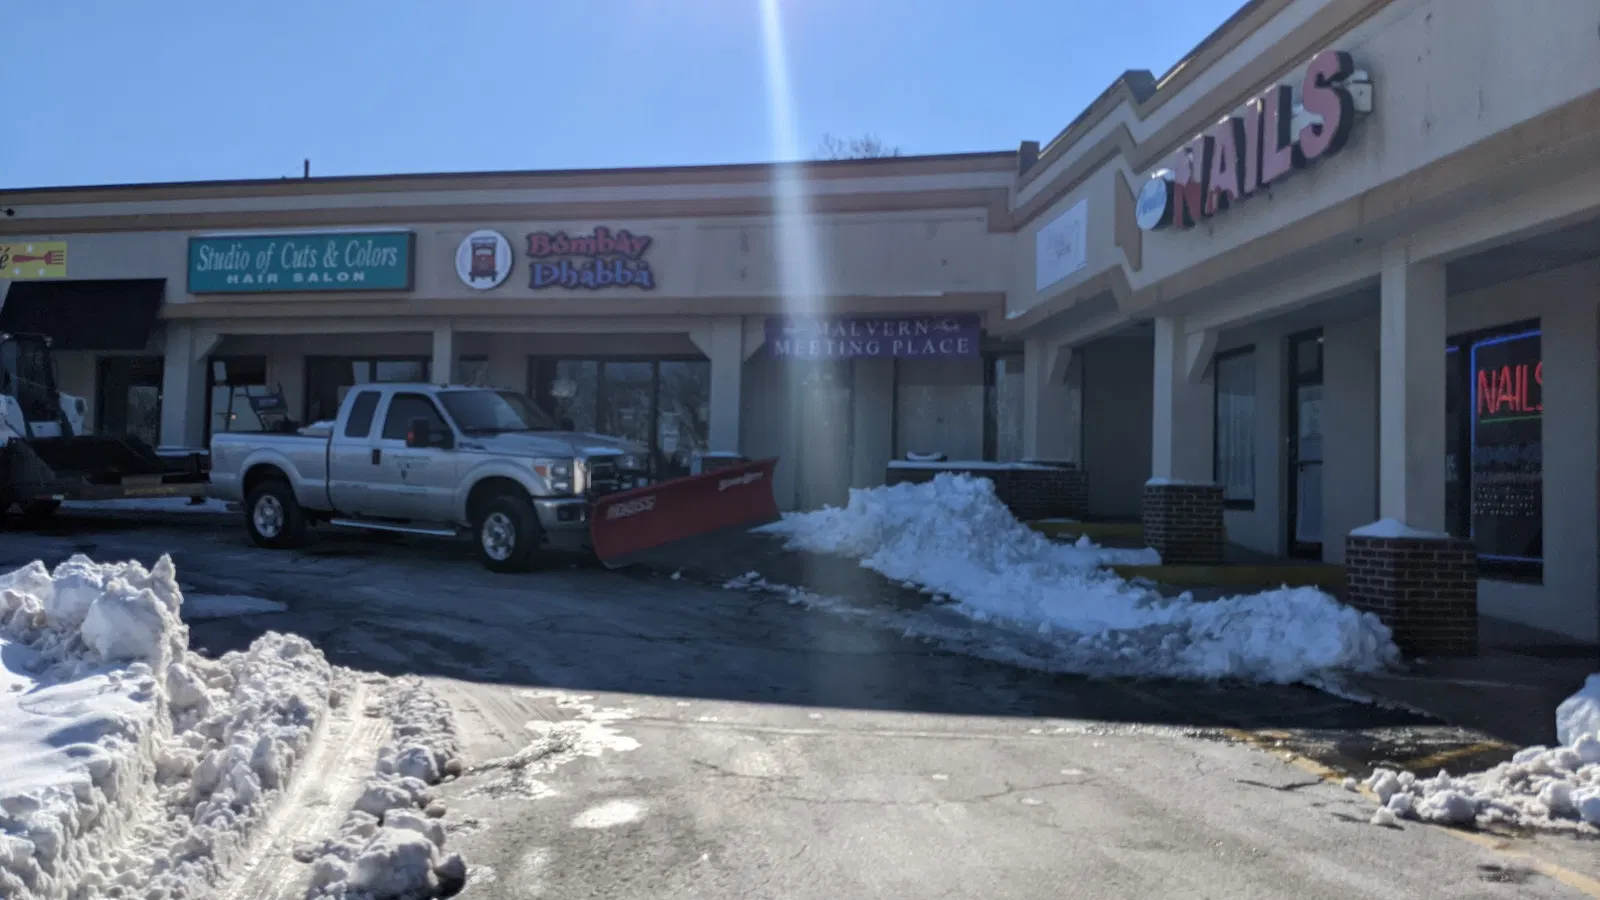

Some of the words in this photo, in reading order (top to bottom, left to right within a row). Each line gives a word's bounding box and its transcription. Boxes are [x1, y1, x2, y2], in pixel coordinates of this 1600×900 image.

[1172, 50, 1354, 229] NAILS
[197, 242, 251, 272] Studio
[256, 241, 276, 275] of
[280, 240, 318, 270] Cuts
[322, 239, 339, 268] &
[344, 239, 398, 268] Colors
[527, 227, 653, 260] Bombay
[226, 273, 279, 285] HAIR
[292, 271, 366, 284] SALON
[529, 259, 656, 289] Dhabba
[774, 339, 880, 356] MEETING
[892, 337, 971, 355] PLACE
